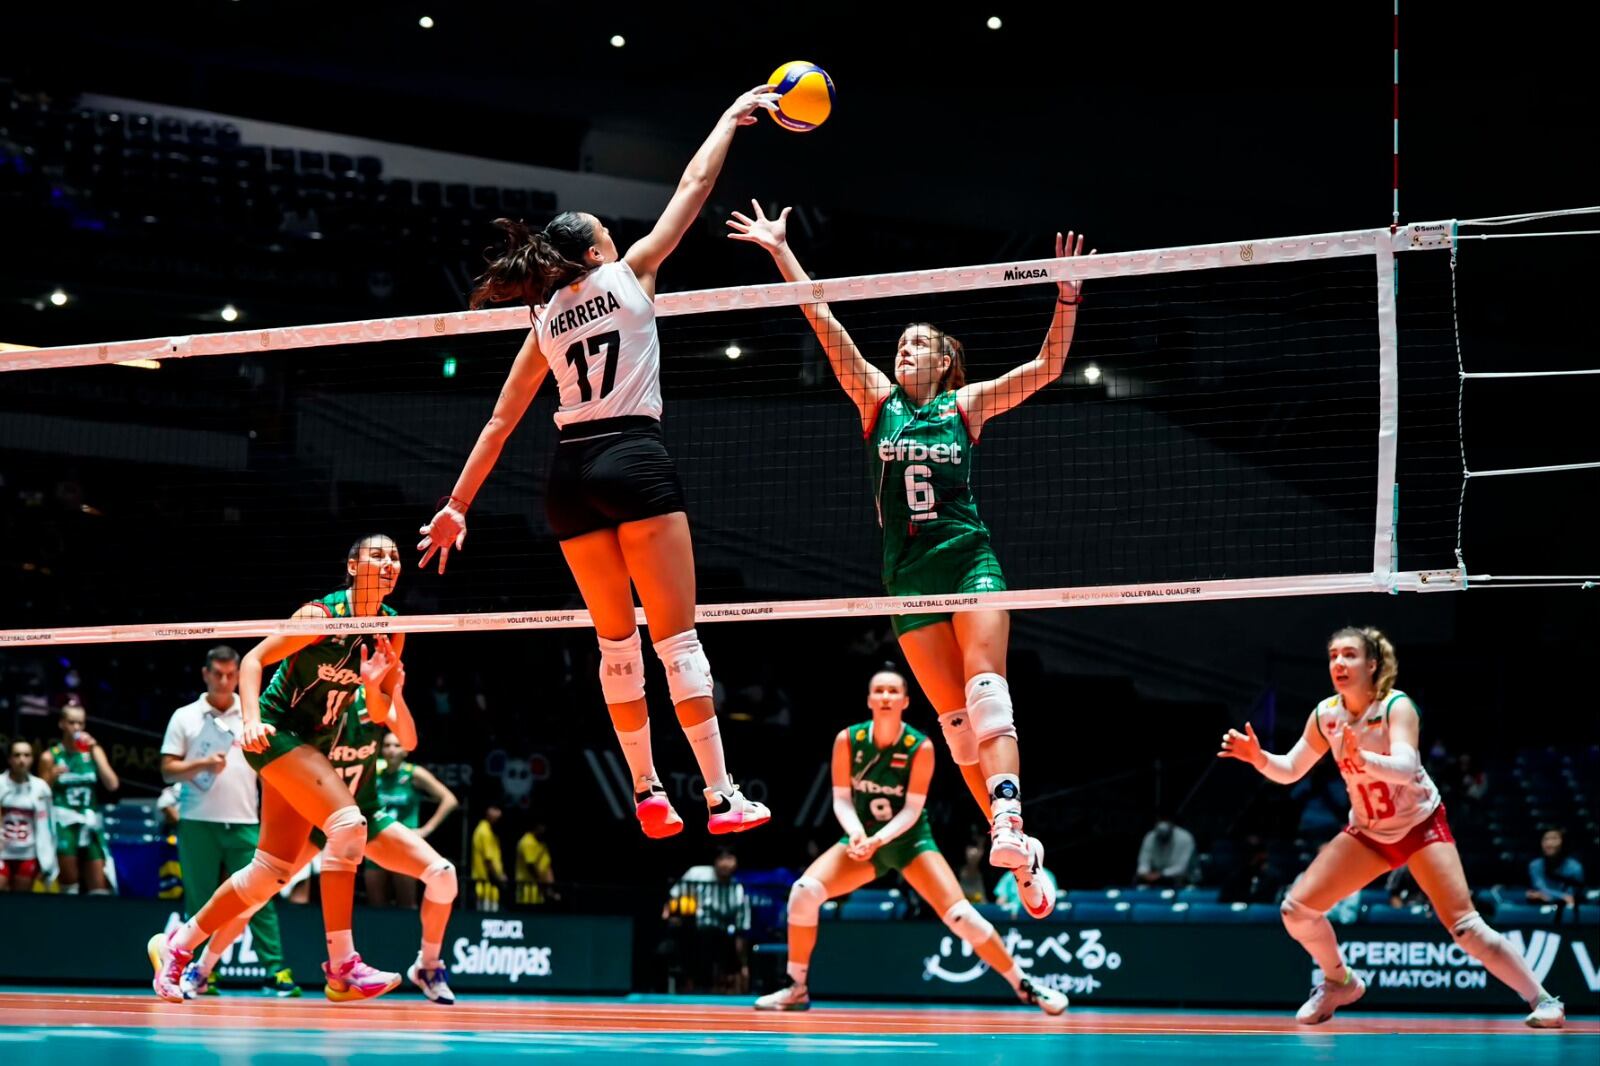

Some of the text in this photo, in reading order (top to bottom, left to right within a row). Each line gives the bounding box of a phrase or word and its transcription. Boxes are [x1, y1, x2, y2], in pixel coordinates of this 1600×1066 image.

[550, 291, 621, 338] HERRERA
[565, 330, 621, 402] 17
[878, 437, 961, 464] efbet
[904, 465, 936, 511] 6
[902, 600, 943, 608] VOLLEYBALL
[944, 598, 978, 606] QUALIFIER
[1121, 589, 1164, 598] VOLLEYBALL
[1165, 587, 1201, 596] QUALIFIER
[507, 616, 543, 624] VOLLEYBALL
[702, 607, 773, 617] VOLLEYBALL QUALIFIER
[325, 622, 359, 630] VOLLEYBALL
[360, 621, 389, 629] QUALIFIER
[317, 663, 363, 685] efb
[606, 662, 633, 677] N1
[328, 740, 377, 761] fbet
[869, 797, 893, 821] 9
[1357, 781, 1396, 819] 13
[451, 937, 551, 982] Salonpas
[1312, 942, 1484, 966] XPERIENC
[1379, 970, 1451, 988] MATCH
[1454, 970, 1487, 988] ON
